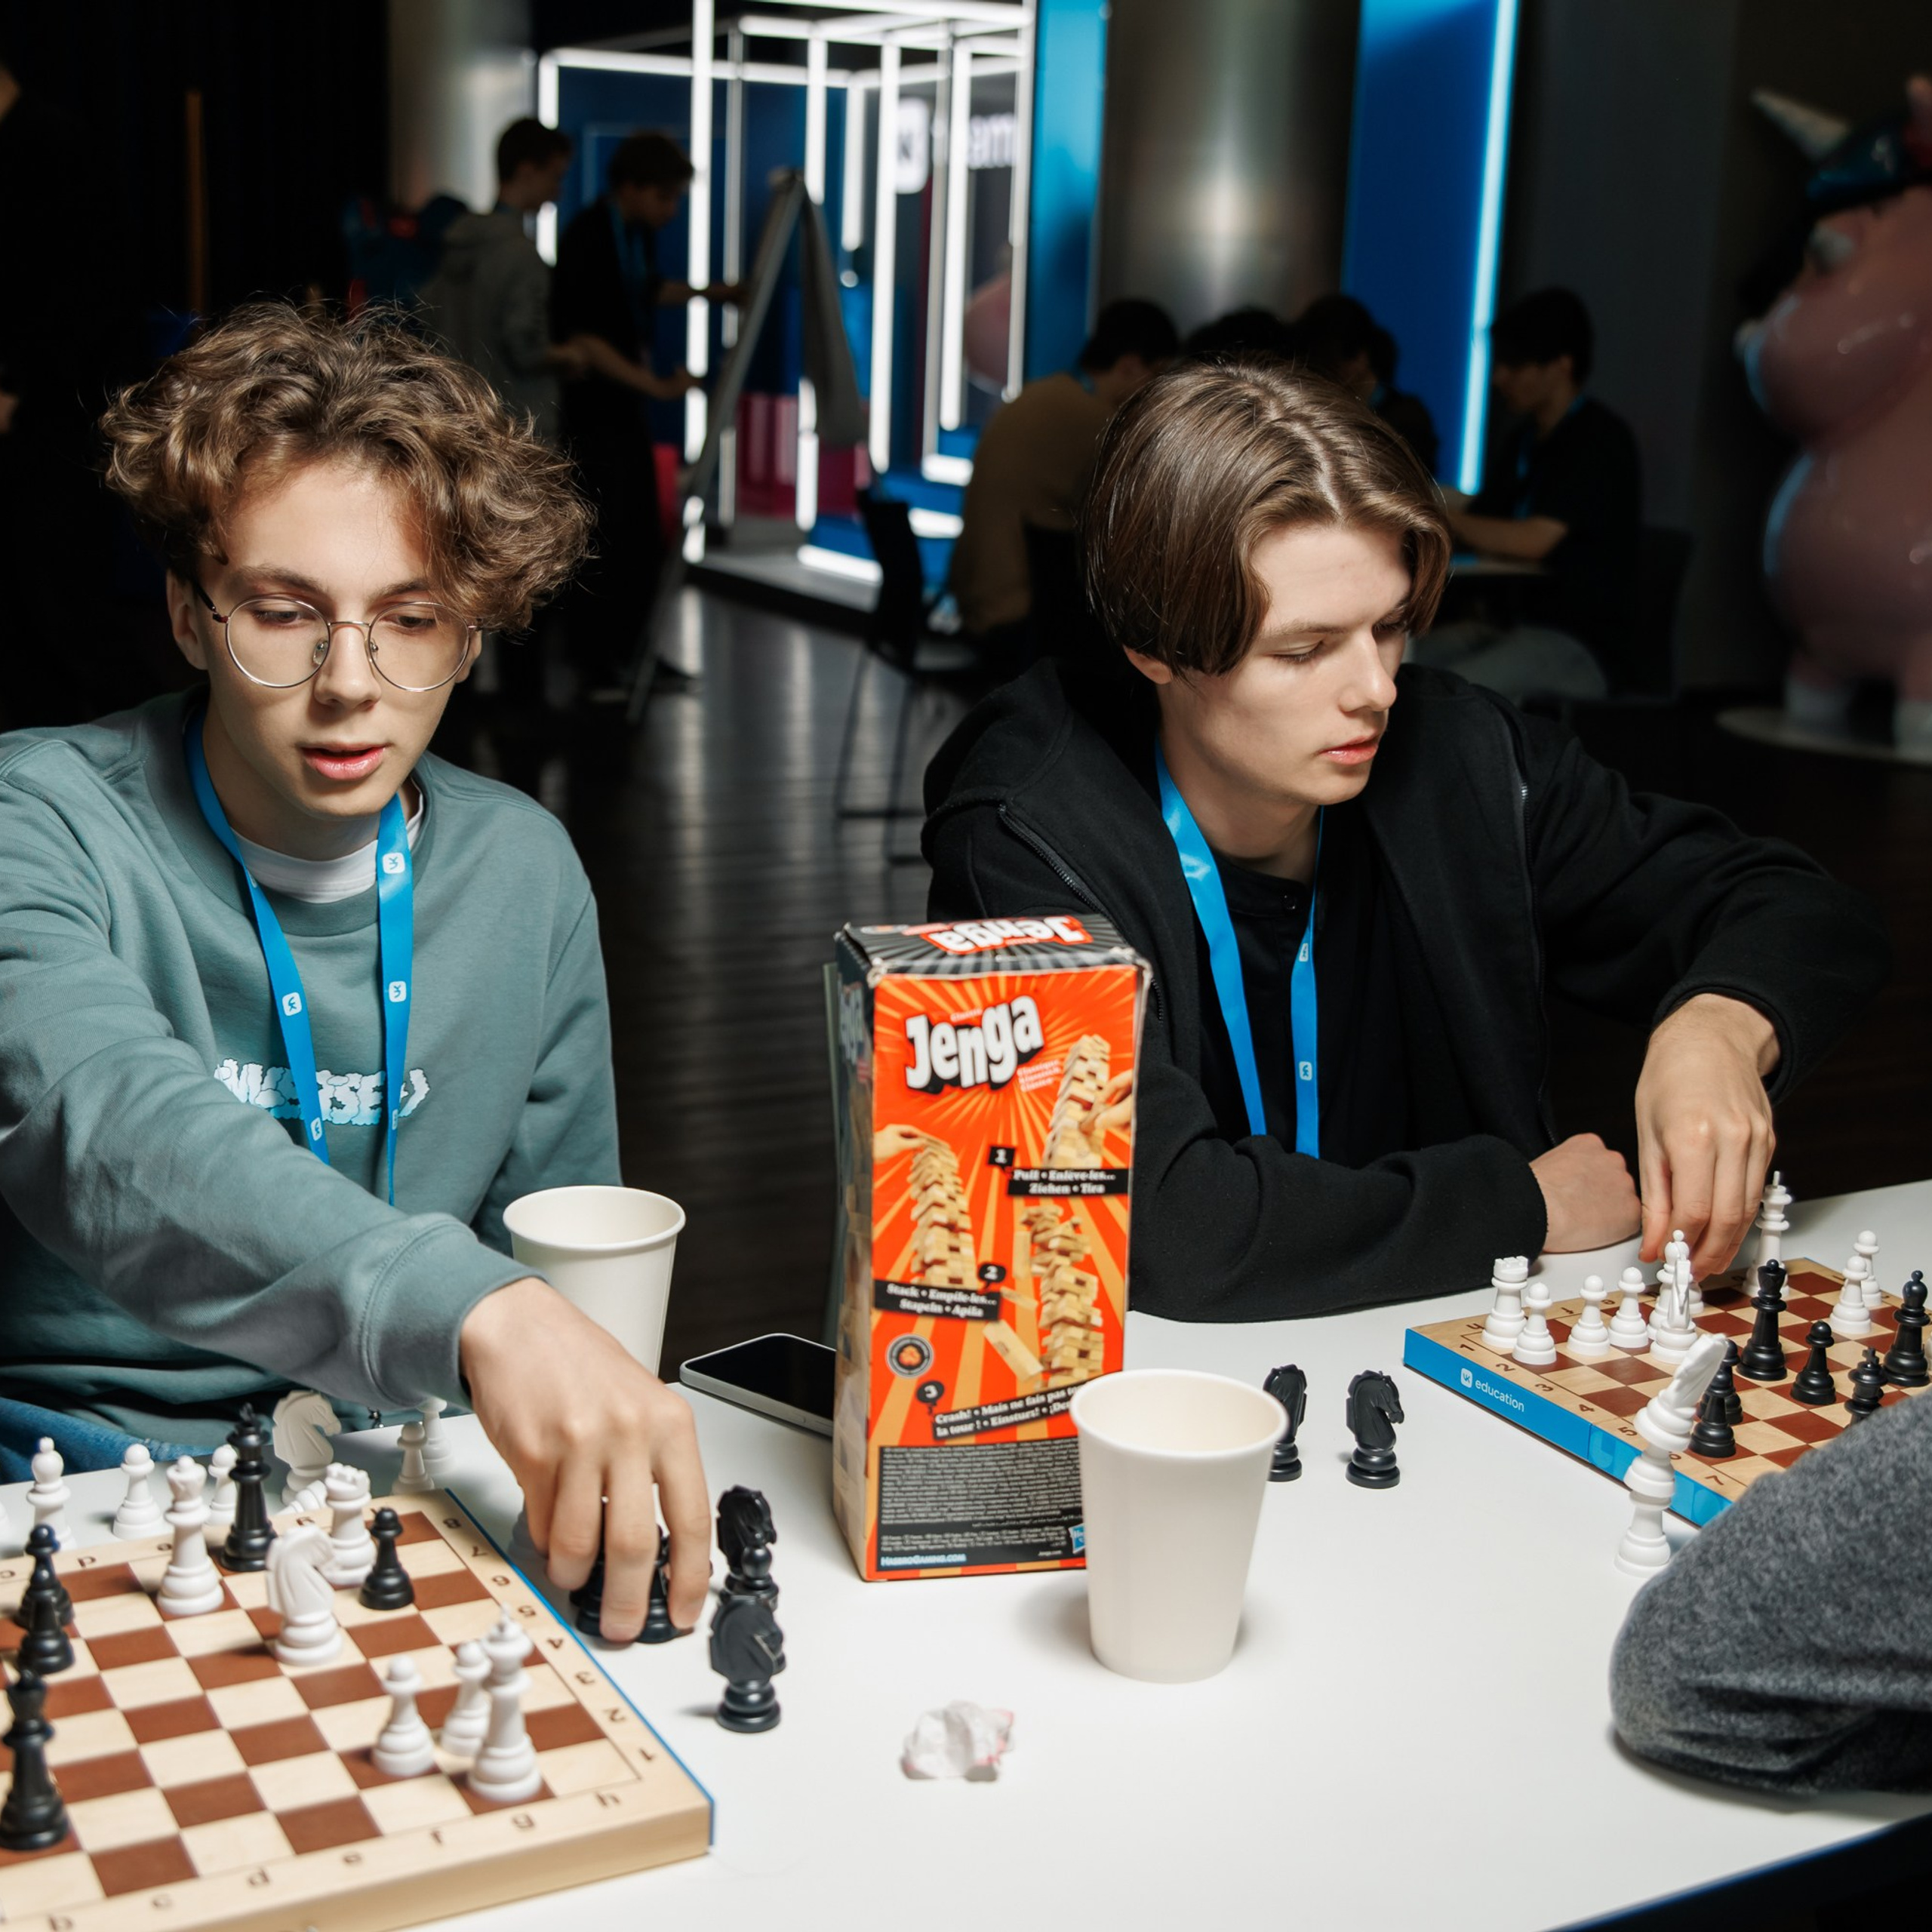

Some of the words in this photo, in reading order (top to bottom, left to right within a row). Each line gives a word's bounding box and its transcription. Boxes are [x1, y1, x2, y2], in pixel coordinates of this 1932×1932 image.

[928, 915, 1085, 952] Jenga
[906, 995, 1044, 1089] Jenga
[995, 1149, 1008, 1164] 1
[1013, 1169, 1040, 1181] Pull
[1029, 1183, 1071, 1194] Ziehen
[1081, 1183, 1106, 1194] Tira
[984, 1265, 998, 1281] 2
[887, 1283, 920, 1298] Stack
[924, 1385, 939, 1398] 3
[1475, 1379, 1525, 1413] education
[935, 1409, 972, 1425] Crash!
[981, 1401, 1009, 1417] Mais
[1010, 1400, 1024, 1411] ne
[1025, 1394, 1046, 1407] fais
[1047, 1389, 1066, 1404] pas
[1496, 1362, 1516, 1372] 2
[1580, 1404, 1595, 1414] 4
[1618, 1426, 1638, 1437] 5
[936, 1426, 949, 1437] la
[949, 1422, 975, 1435] tour
